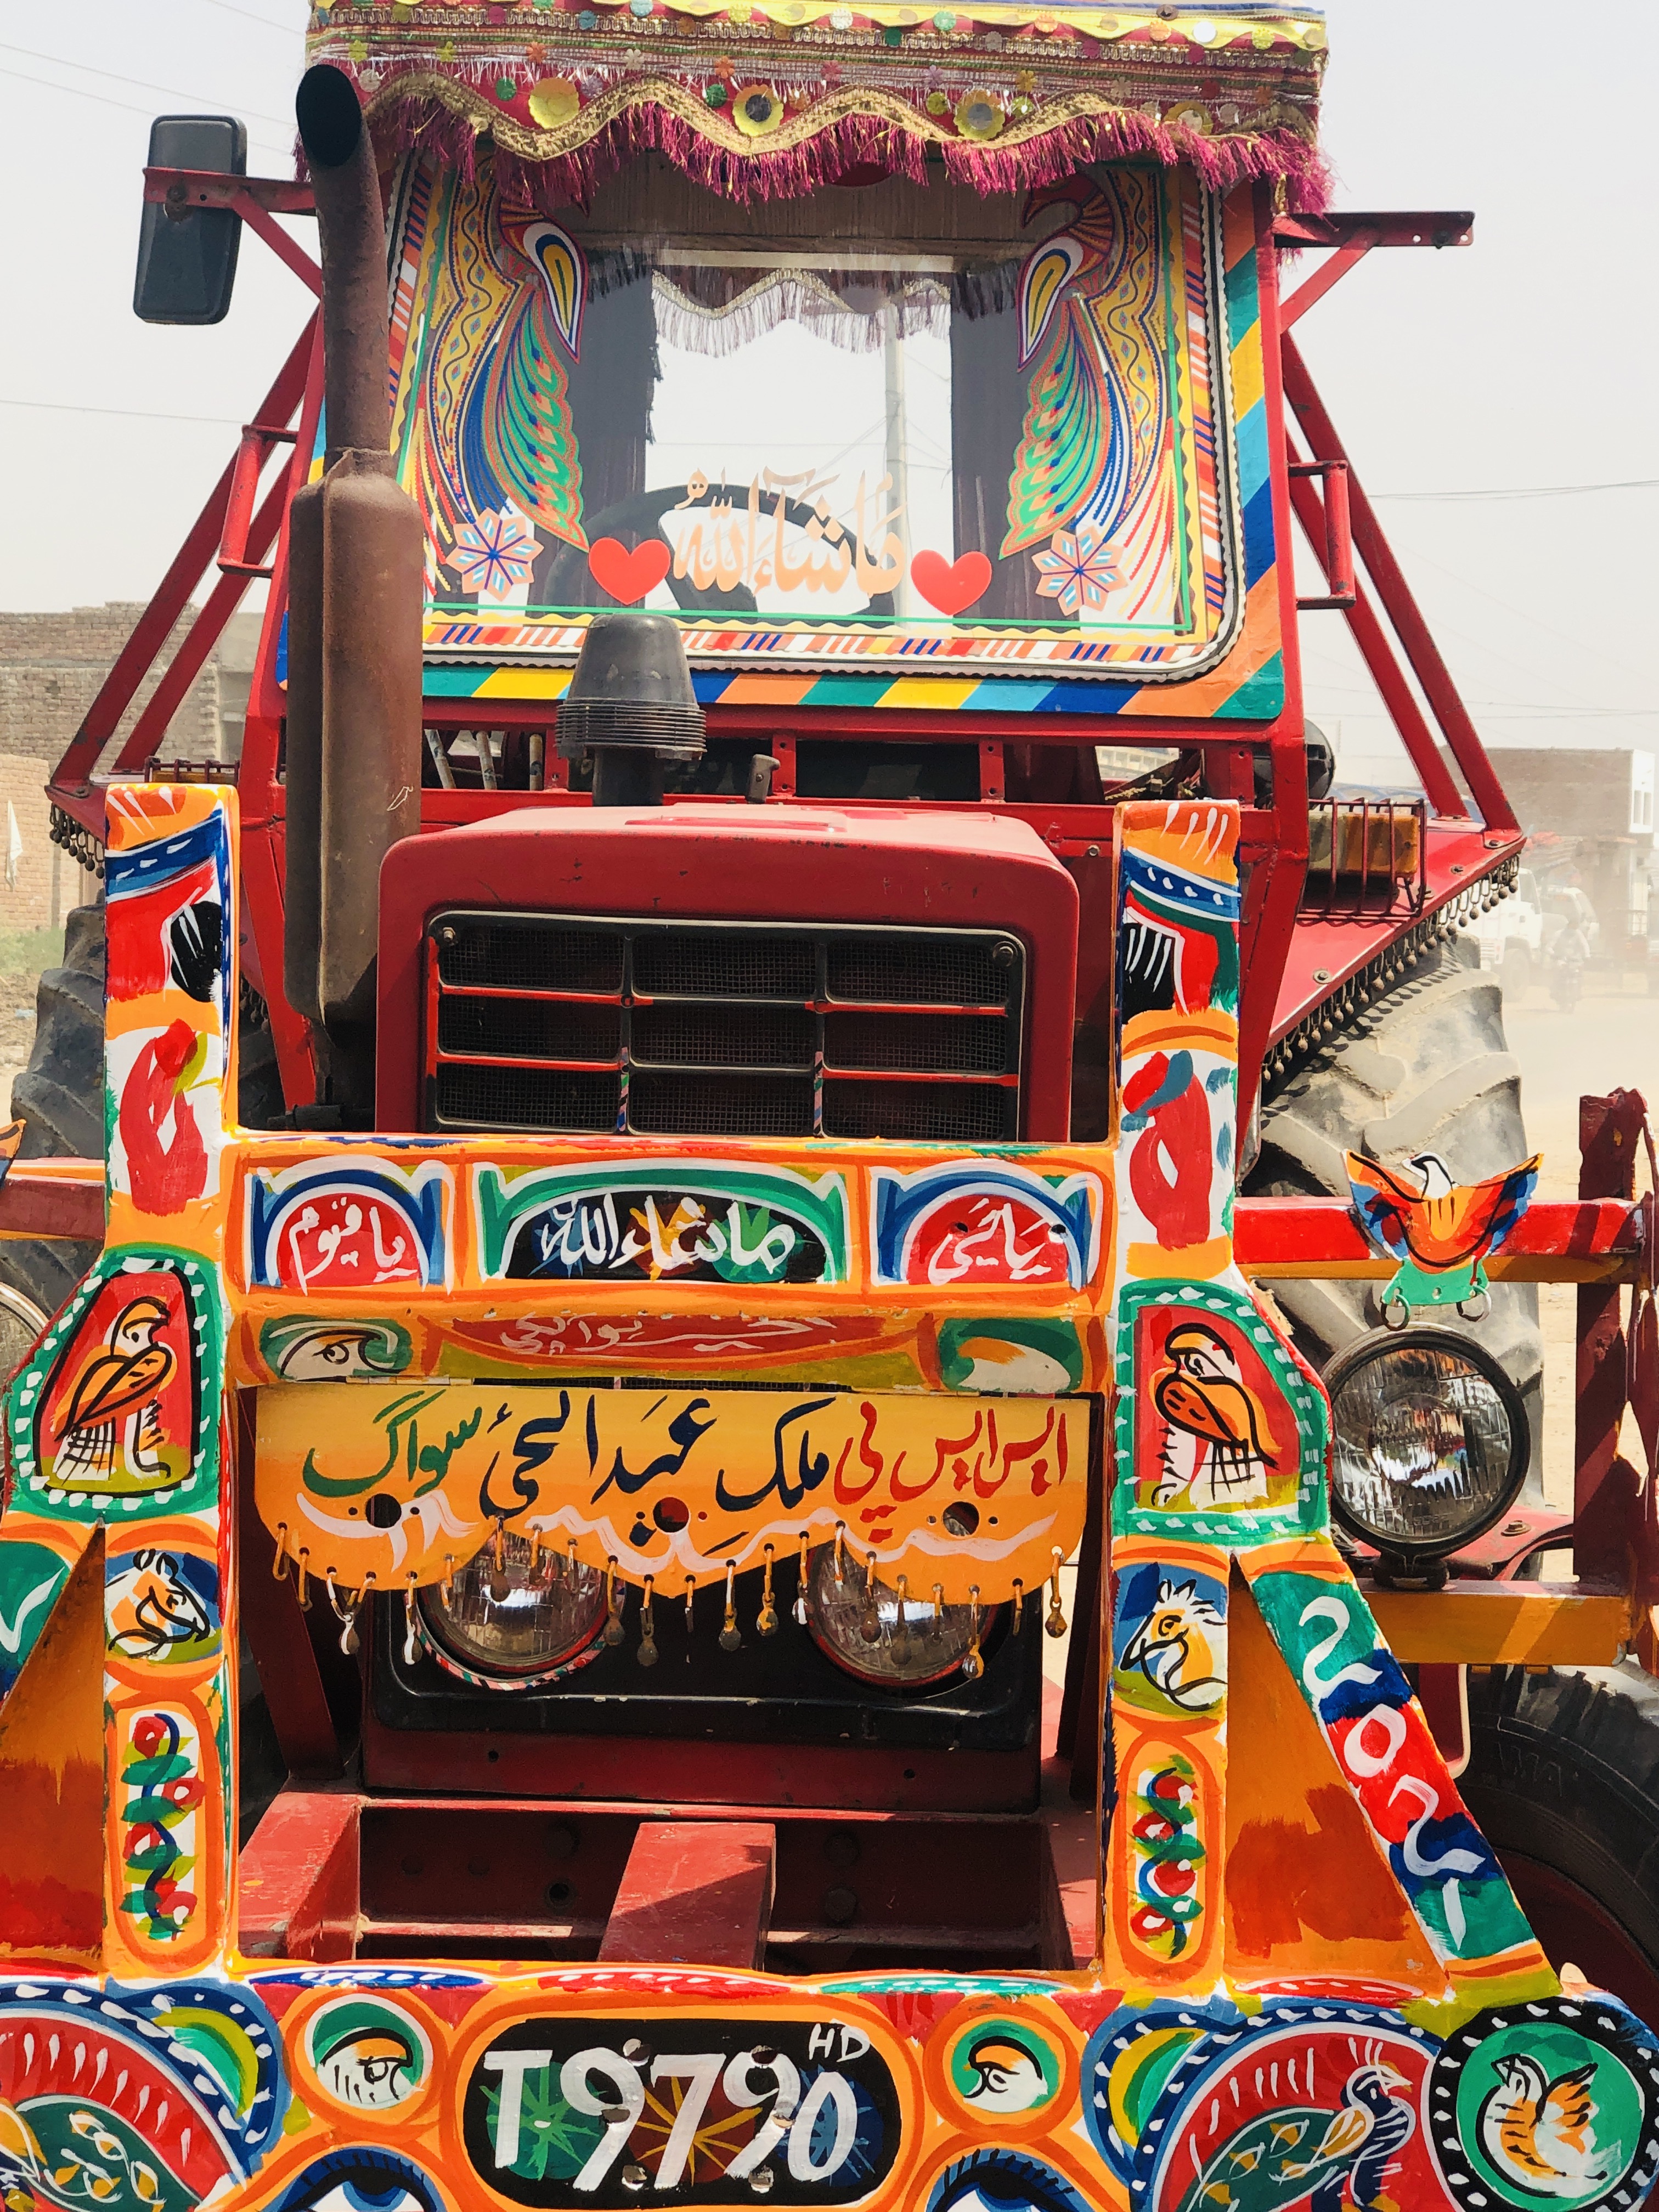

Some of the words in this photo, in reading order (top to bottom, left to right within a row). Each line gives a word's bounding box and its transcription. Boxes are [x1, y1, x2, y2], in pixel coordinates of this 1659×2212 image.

[715, 1396, 836, 1511] ملک
[1298, 1595, 1486, 1951] 2021
[809, 2018, 871, 2063] HD
